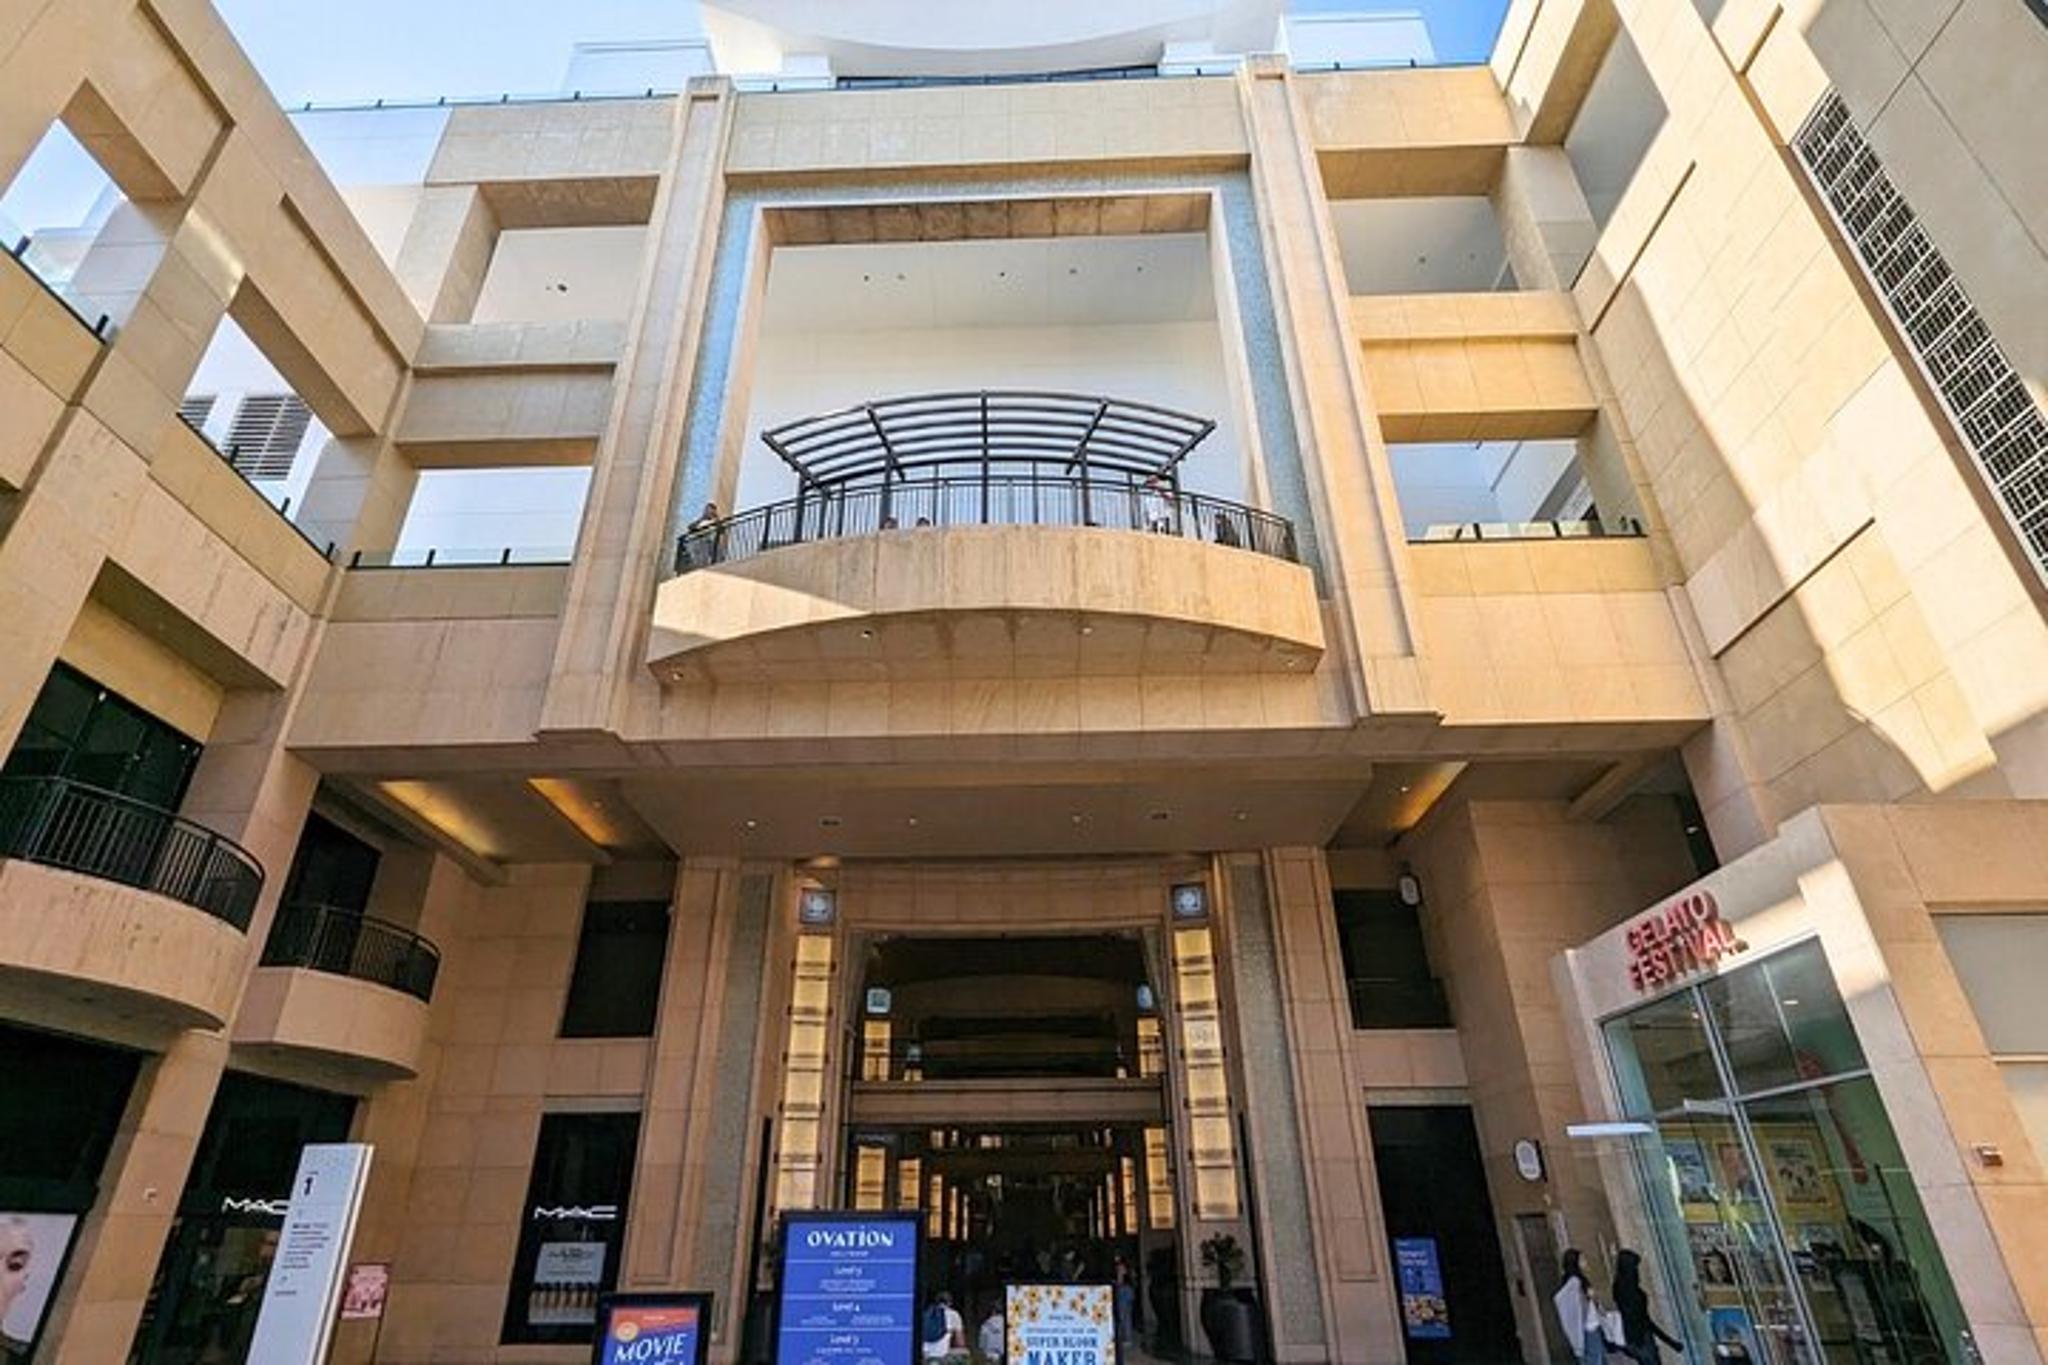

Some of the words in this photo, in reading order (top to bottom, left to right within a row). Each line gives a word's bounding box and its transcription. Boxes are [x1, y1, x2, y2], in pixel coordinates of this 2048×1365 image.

[1627, 892, 1714, 956] GELATO
[1627, 919, 1736, 990] FESTIVAL
[807, 1225, 894, 1247] OVATION
[614, 1333, 687, 1363] MOVIE
